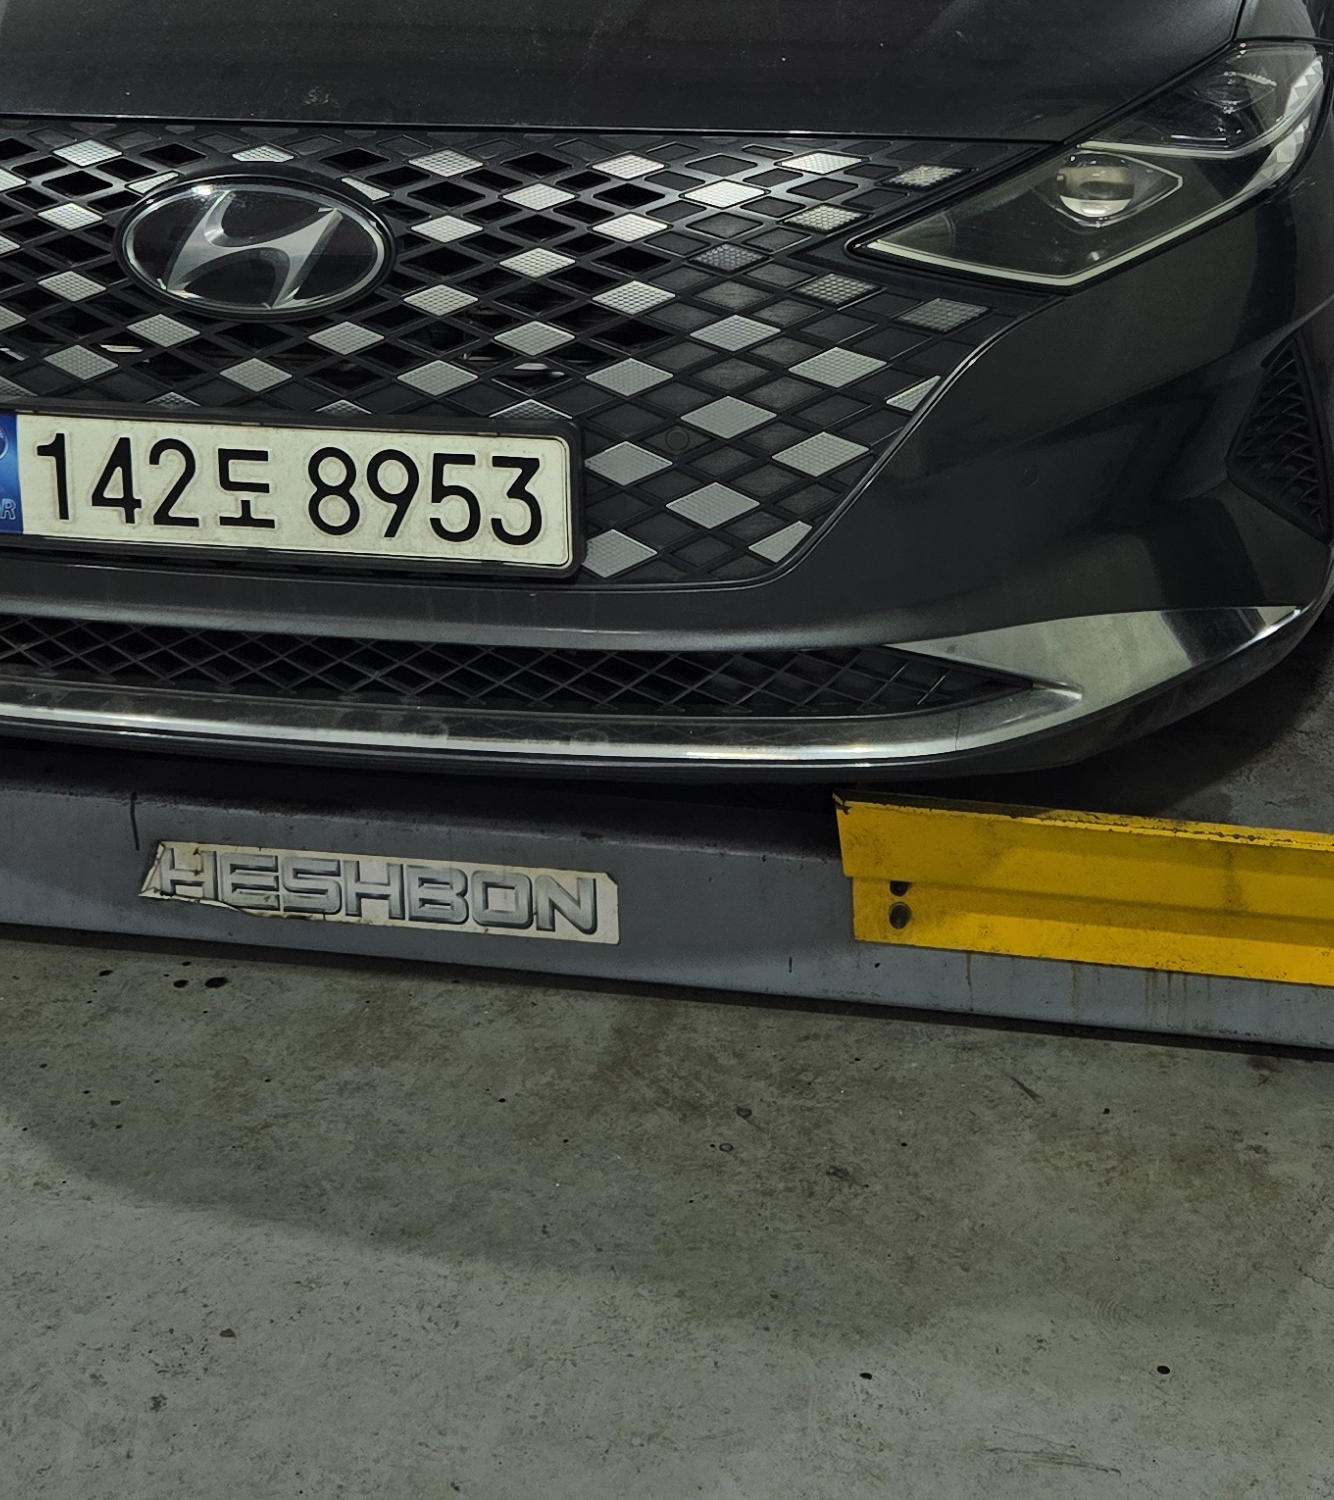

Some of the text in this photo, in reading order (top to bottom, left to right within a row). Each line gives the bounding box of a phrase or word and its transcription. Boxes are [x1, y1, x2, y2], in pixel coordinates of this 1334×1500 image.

[36, 432, 543, 546] 142도 8953
[158, 846, 599, 936] HESHBON
